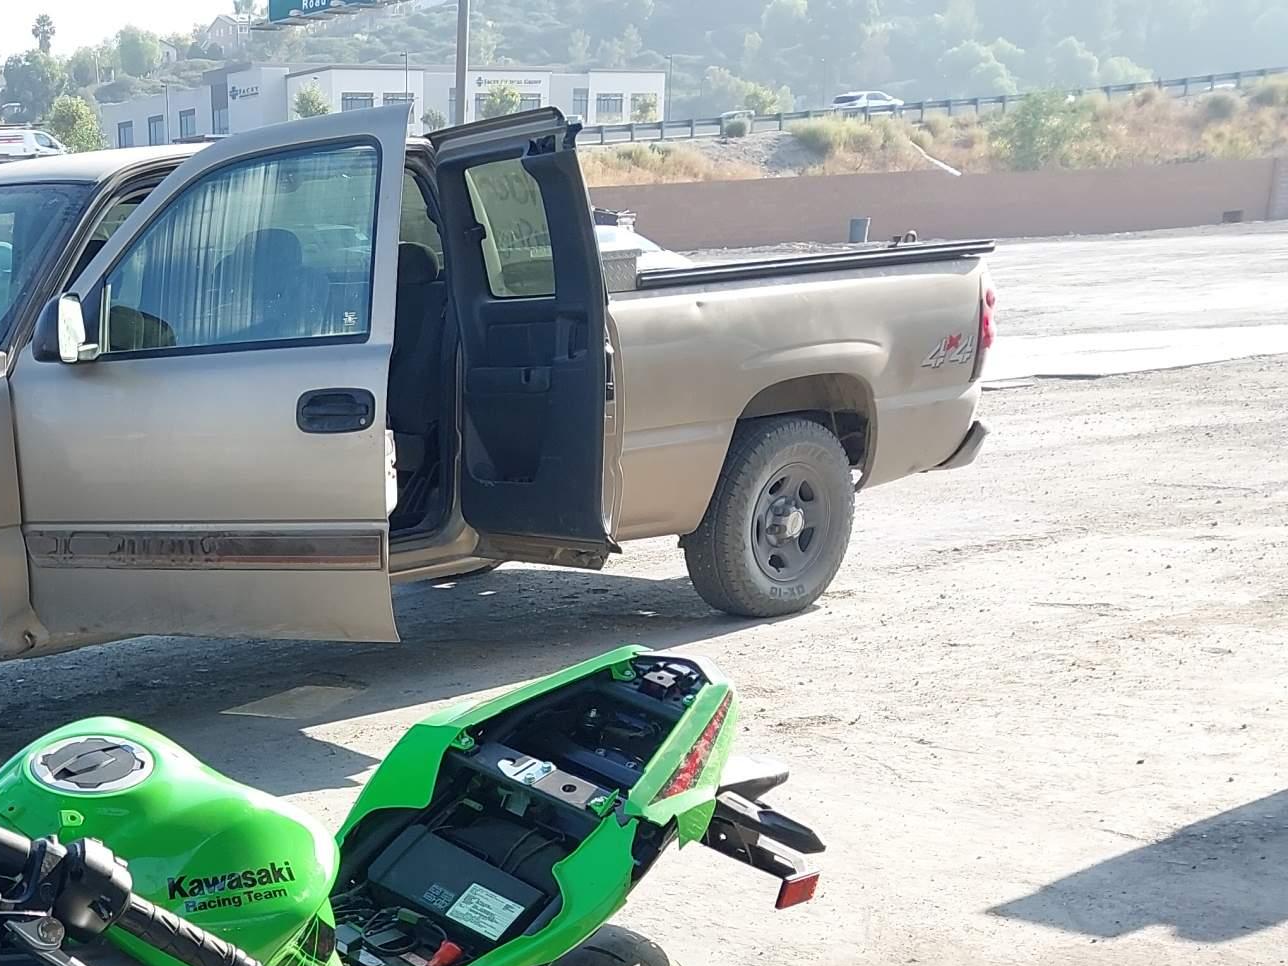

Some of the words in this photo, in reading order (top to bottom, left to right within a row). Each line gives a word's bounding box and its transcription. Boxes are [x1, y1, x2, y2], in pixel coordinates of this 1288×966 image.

[166, 860, 296, 900] Kawasaki
[184, 894, 243, 913] Racing
[243, 887, 288, 903] Team
